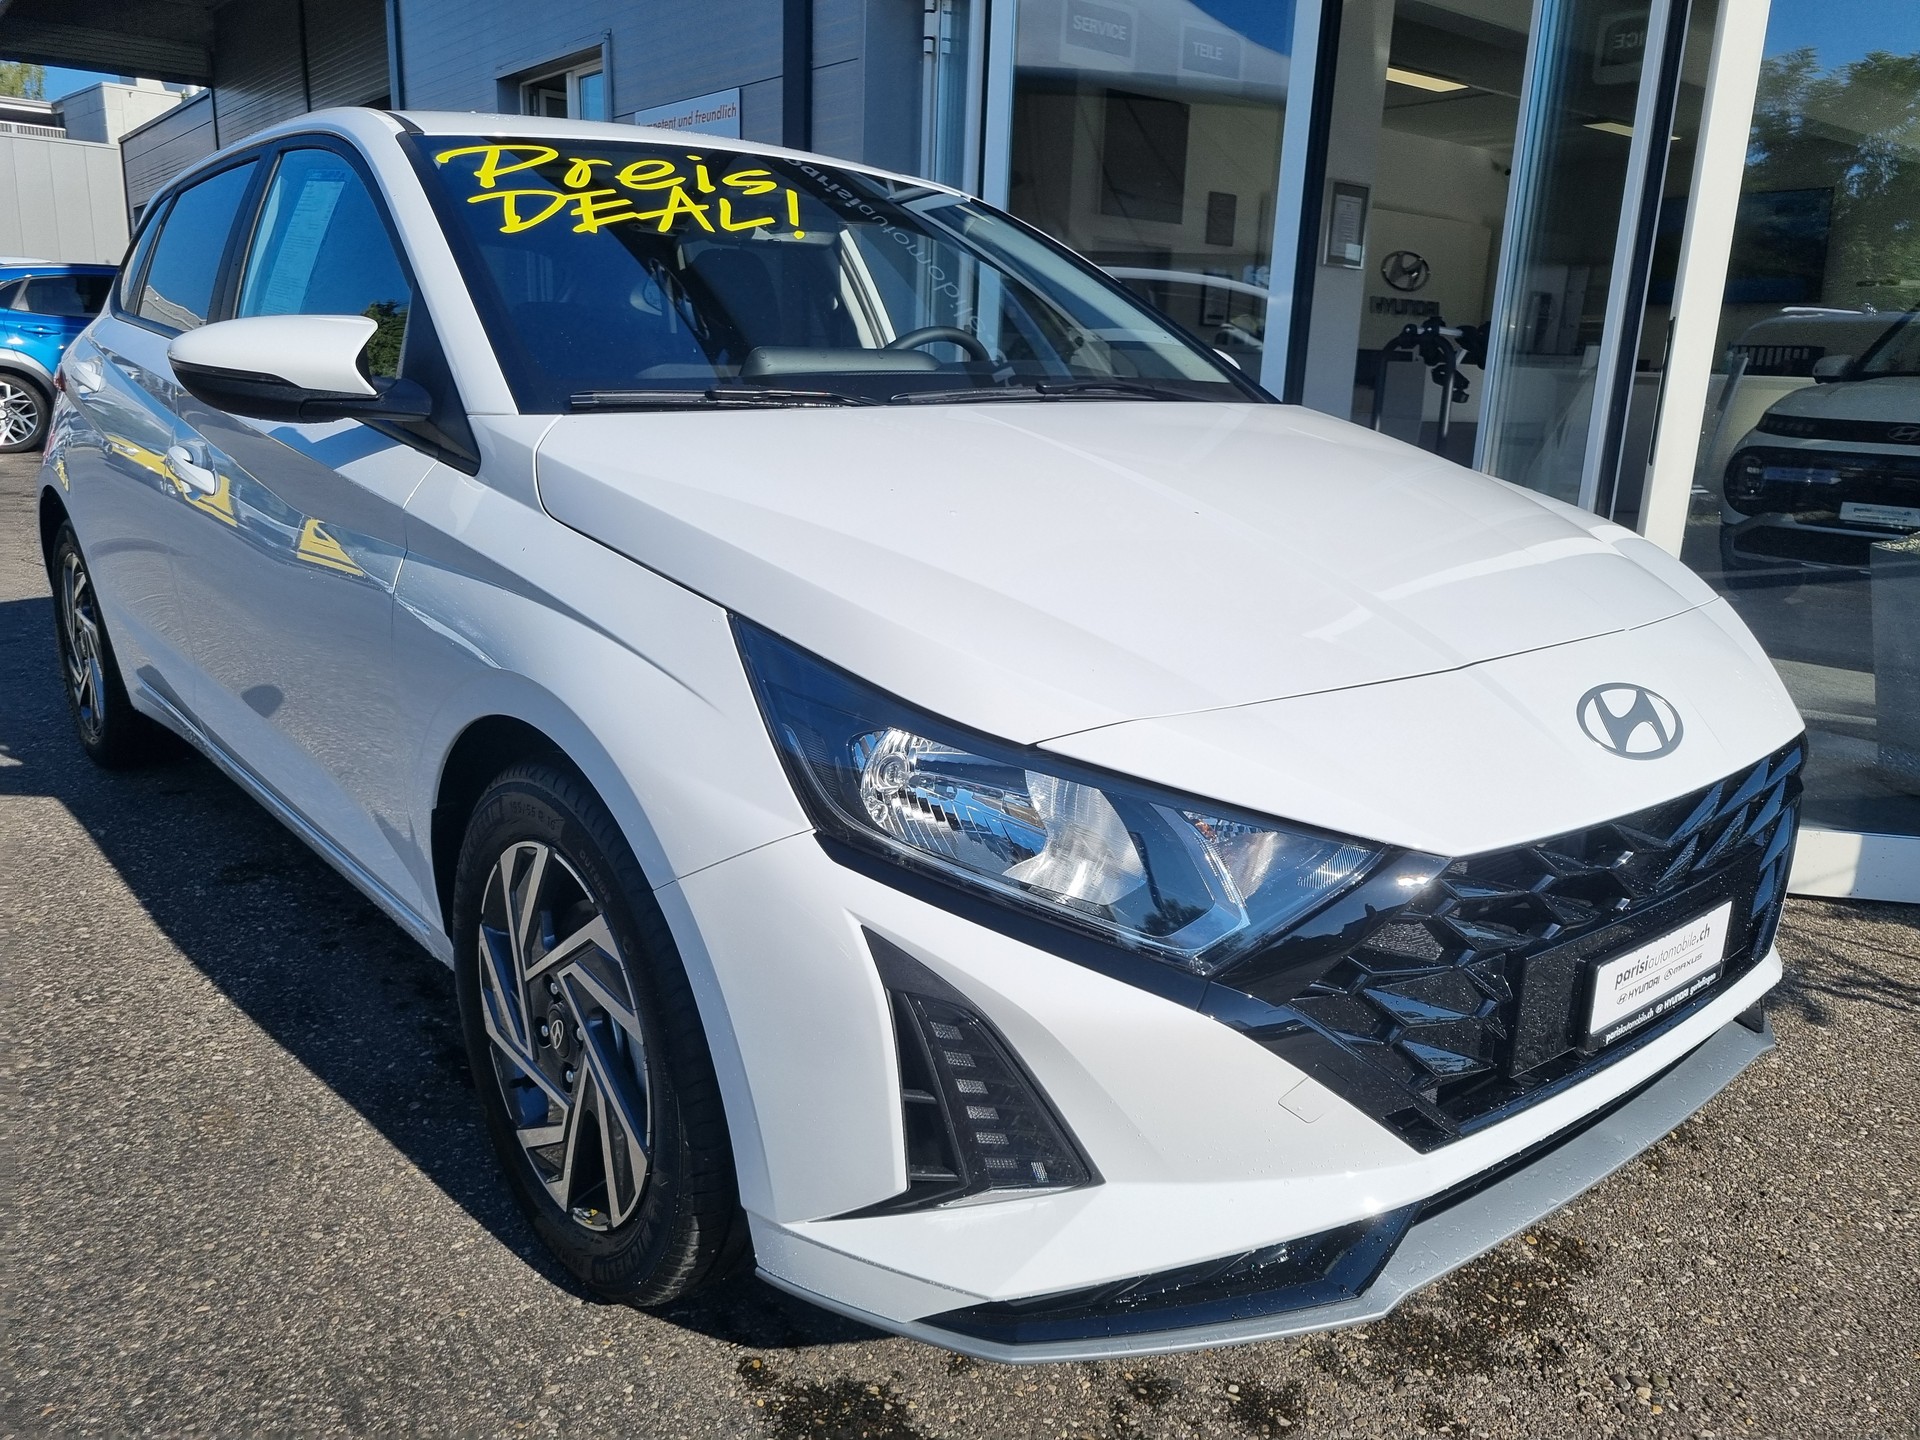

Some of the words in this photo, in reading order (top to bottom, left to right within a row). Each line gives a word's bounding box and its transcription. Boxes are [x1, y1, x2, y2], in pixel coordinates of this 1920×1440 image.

[1072, 14, 1127, 41] SERVICE
[1193, 41, 1223, 61] TEILE
[678, 111, 694, 127] und
[694, 102, 737, 124] freundlich
[435, 144, 778, 196] Preis
[466, 186, 805, 240] DEAL!
[1614, 923, 1711, 990] parisiautomobile.ch
[1627, 975, 1661, 1000] HYUNDAI
[1664, 987, 1689, 1011] HYUNDAI
